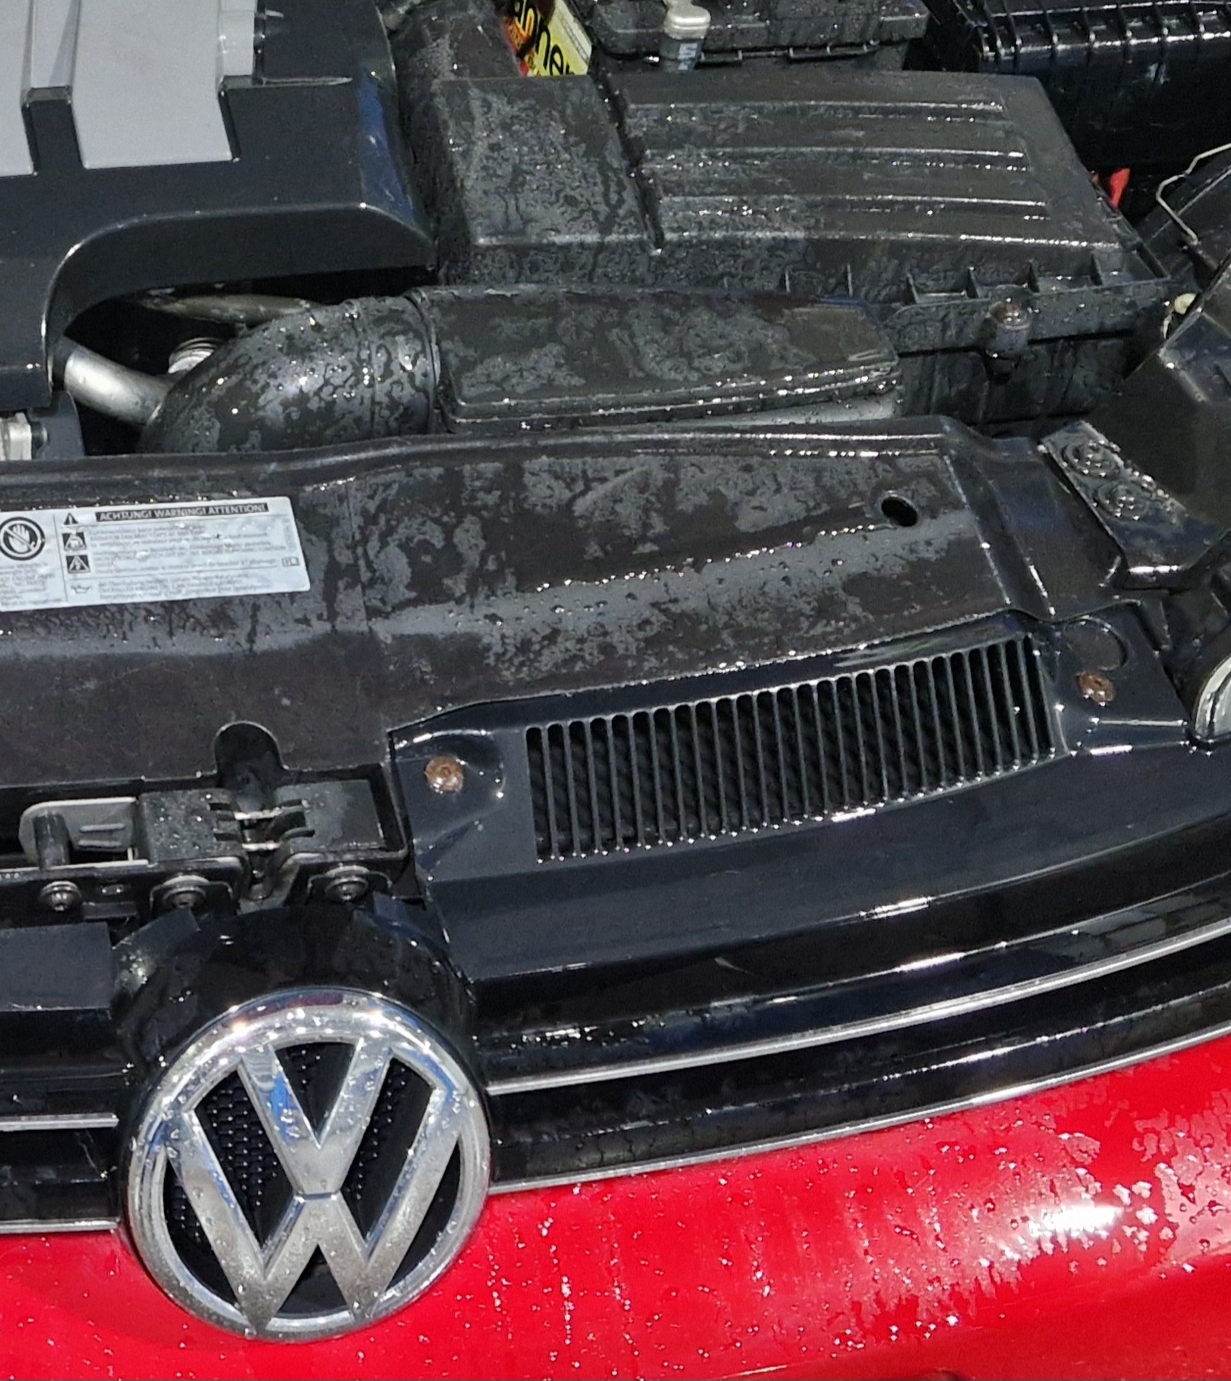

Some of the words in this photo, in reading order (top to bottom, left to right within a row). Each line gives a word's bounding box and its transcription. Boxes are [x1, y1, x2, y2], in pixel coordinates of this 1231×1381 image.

[154, 506, 207, 519] WARNING!
[208, 503, 266, 516] ATTENTION!
[137, 1000, 481, 1339] VW
